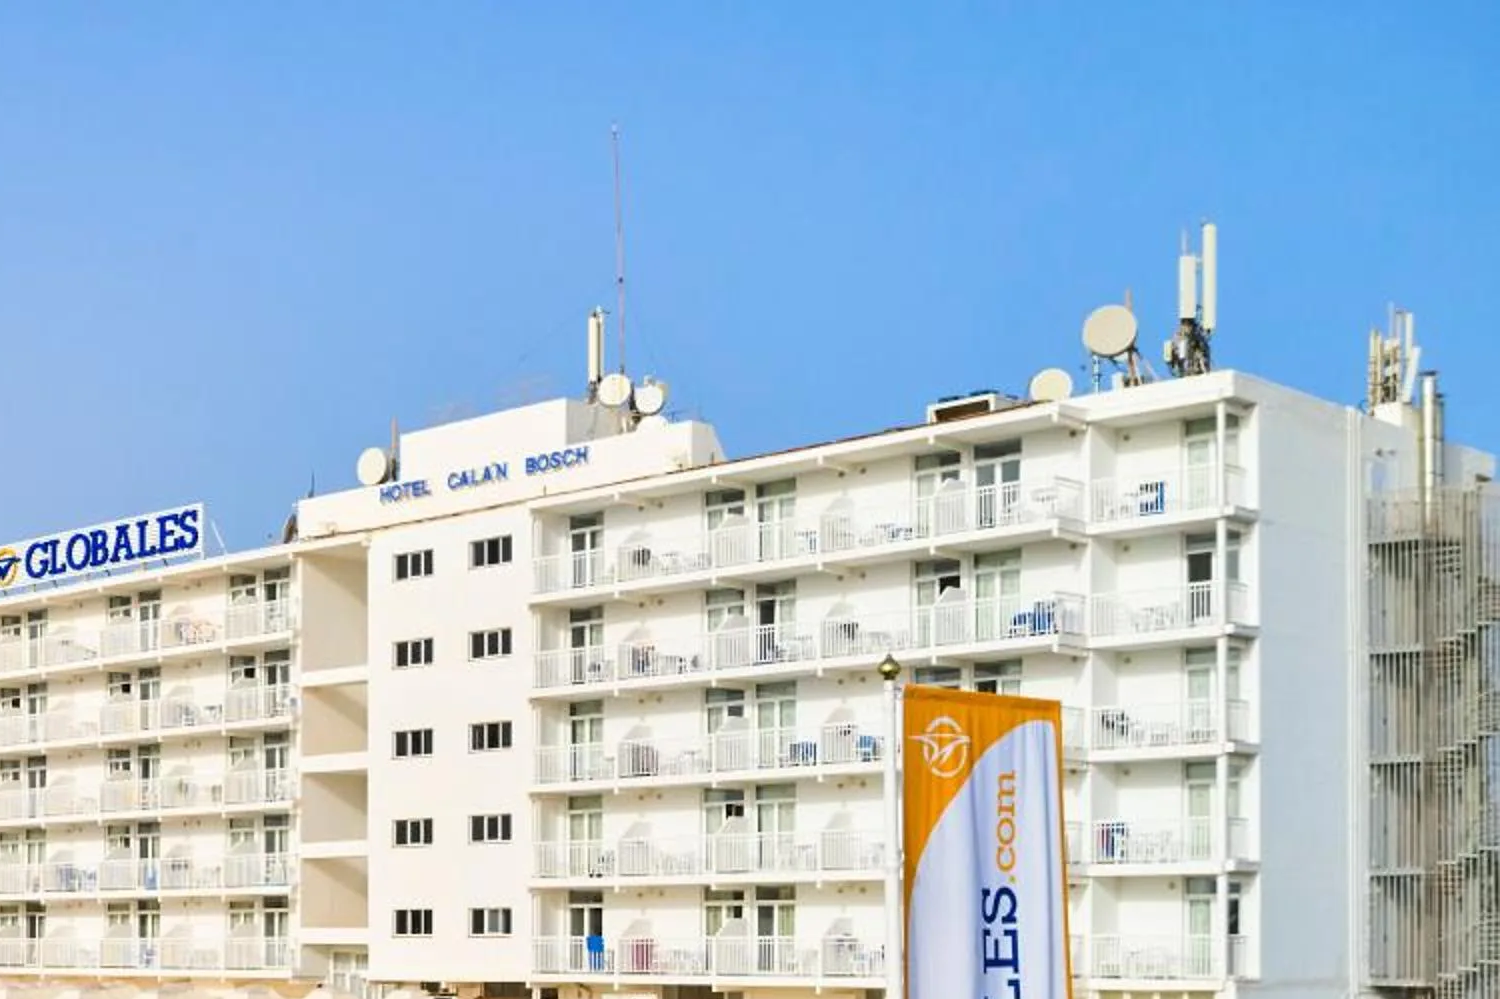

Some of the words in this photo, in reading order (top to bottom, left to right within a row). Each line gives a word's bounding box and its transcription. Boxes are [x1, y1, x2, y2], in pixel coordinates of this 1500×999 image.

[379, 479, 432, 505] HOTEL
[525, 446, 589, 475] BOSCH
[25, 509, 199, 579] GLOBALES
